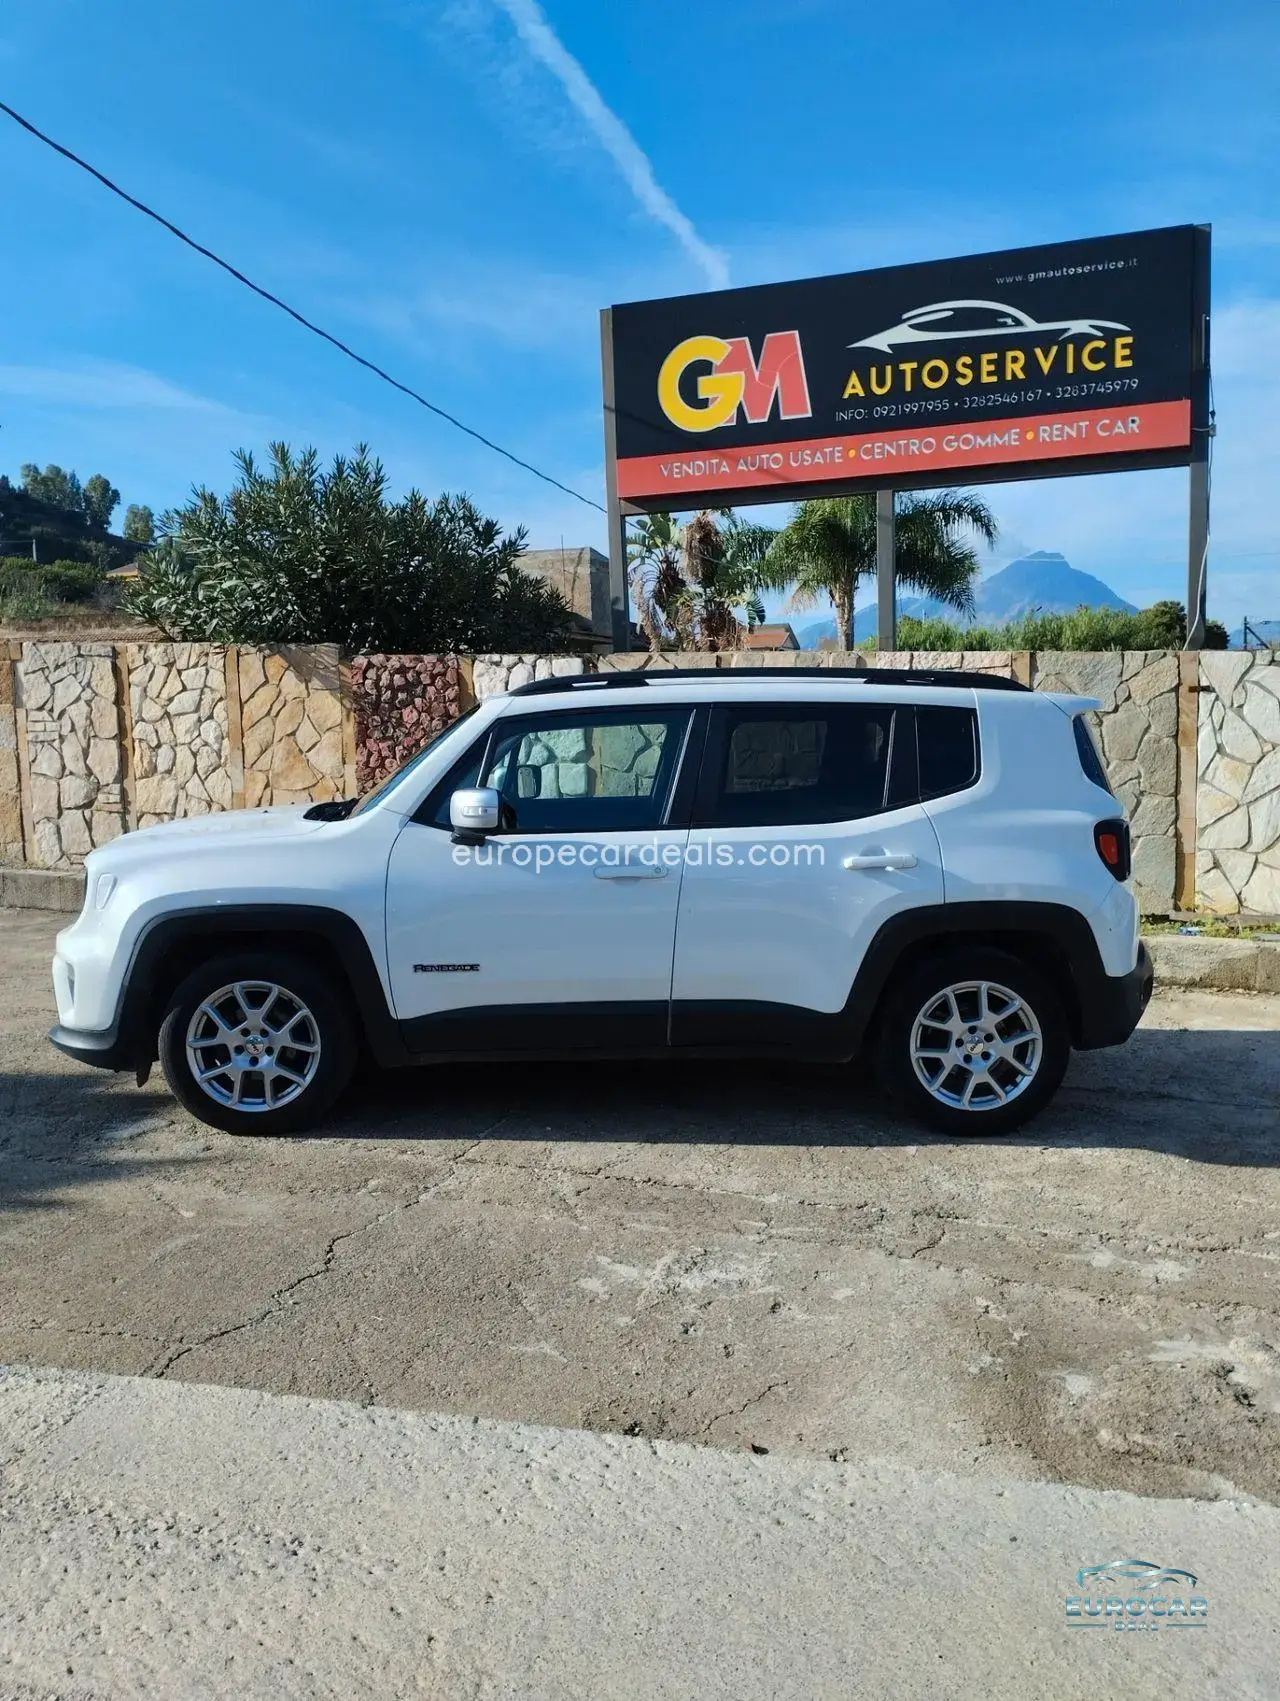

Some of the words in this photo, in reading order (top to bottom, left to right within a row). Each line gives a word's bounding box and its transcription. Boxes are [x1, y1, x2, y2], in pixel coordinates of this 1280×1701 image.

[996, 258, 1138, 284] www.gmautoservice.it
[657, 330, 812, 433] GM
[842, 335, 1134, 399] AUTOSERVICE
[835, 408, 868, 421] INFO:
[873, 399, 949, 418] 0921997955
[963, 389, 1042, 408] 3282546167
[1055, 379, 1139, 398] 3283745979
[660, 458, 730, 478] VENDITA
[736, 453, 783, 472] AUTO
[789, 446, 843, 467] USATE
[859, 437, 936, 460] CENTRO
[942, 428, 1020, 451] GOMME
[1039, 421, 1089, 443] RENT
[1096, 416, 1140, 437] CAR
